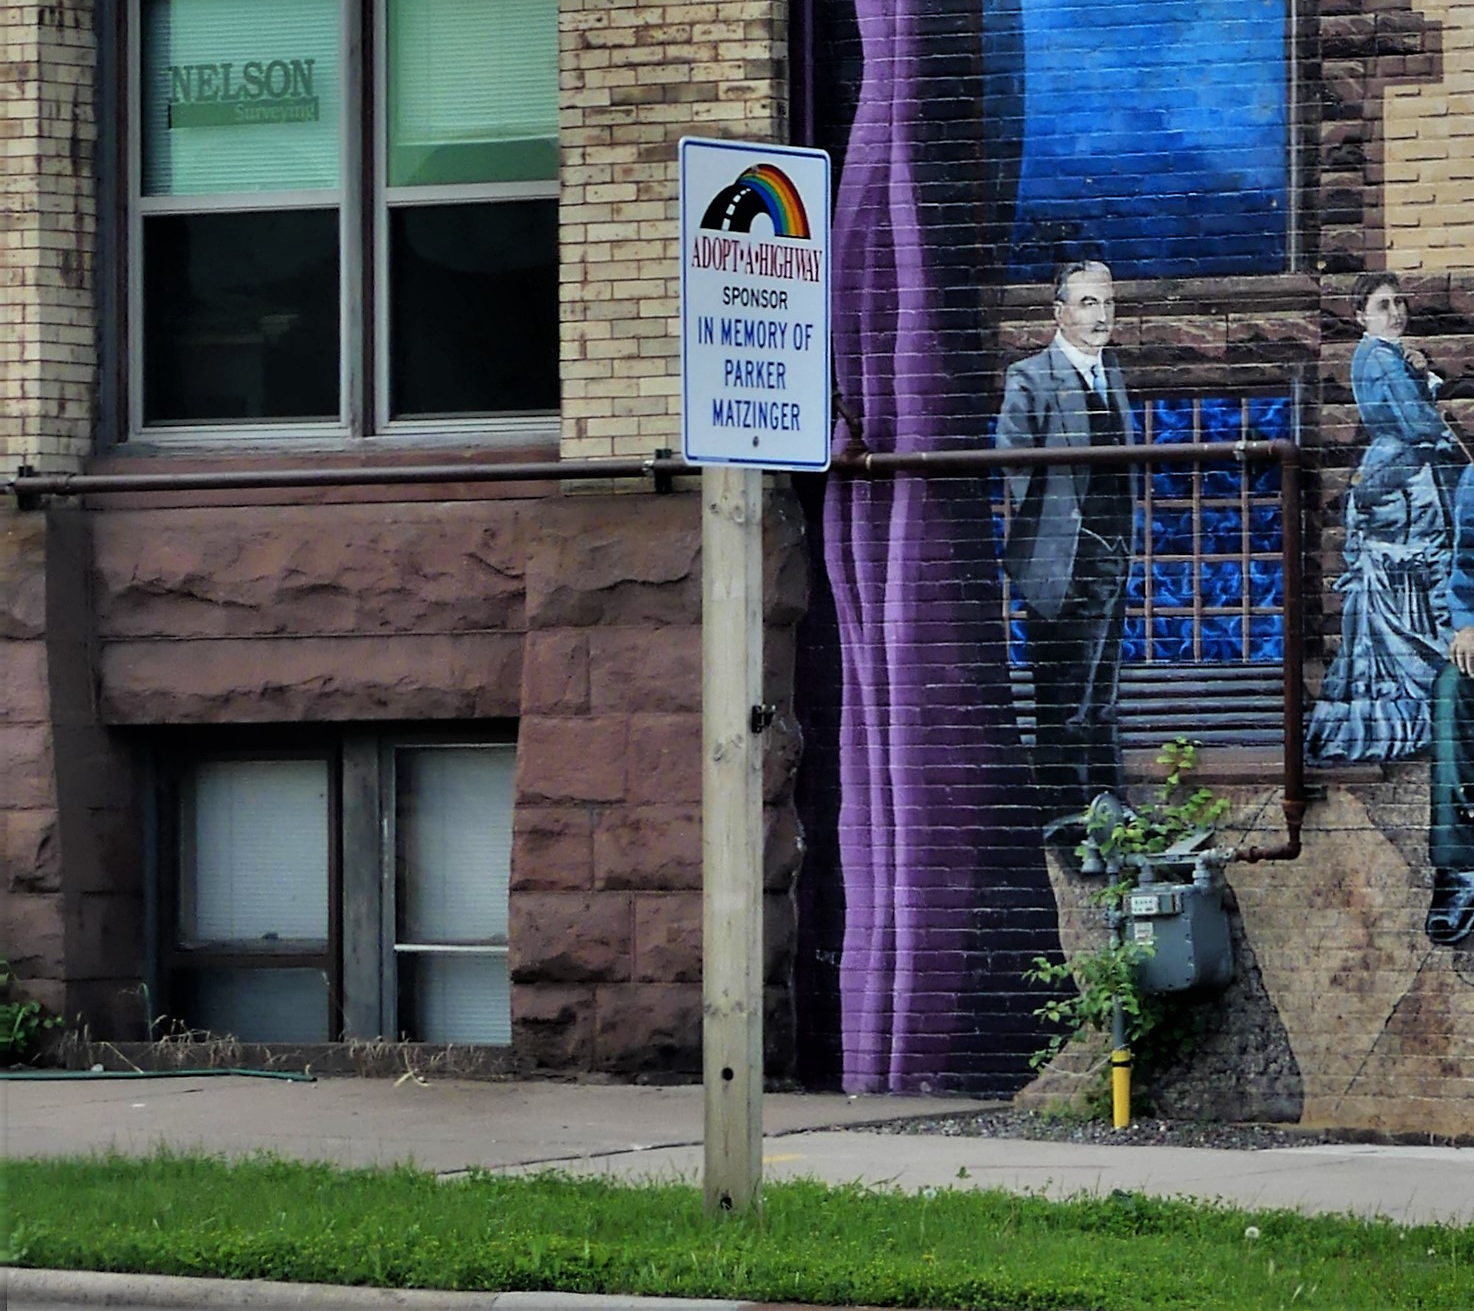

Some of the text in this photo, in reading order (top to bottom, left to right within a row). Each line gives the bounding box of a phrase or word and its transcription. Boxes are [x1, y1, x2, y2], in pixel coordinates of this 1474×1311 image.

[168, 58, 315, 103] NELSON
[234, 102, 315, 124] Surveying
[723, 286, 788, 310] SPONSOR
[698, 316, 814, 351] IN MEMORY OF
[724, 359, 786, 390] PARKER
[712, 398, 801, 431] MATZINGER
